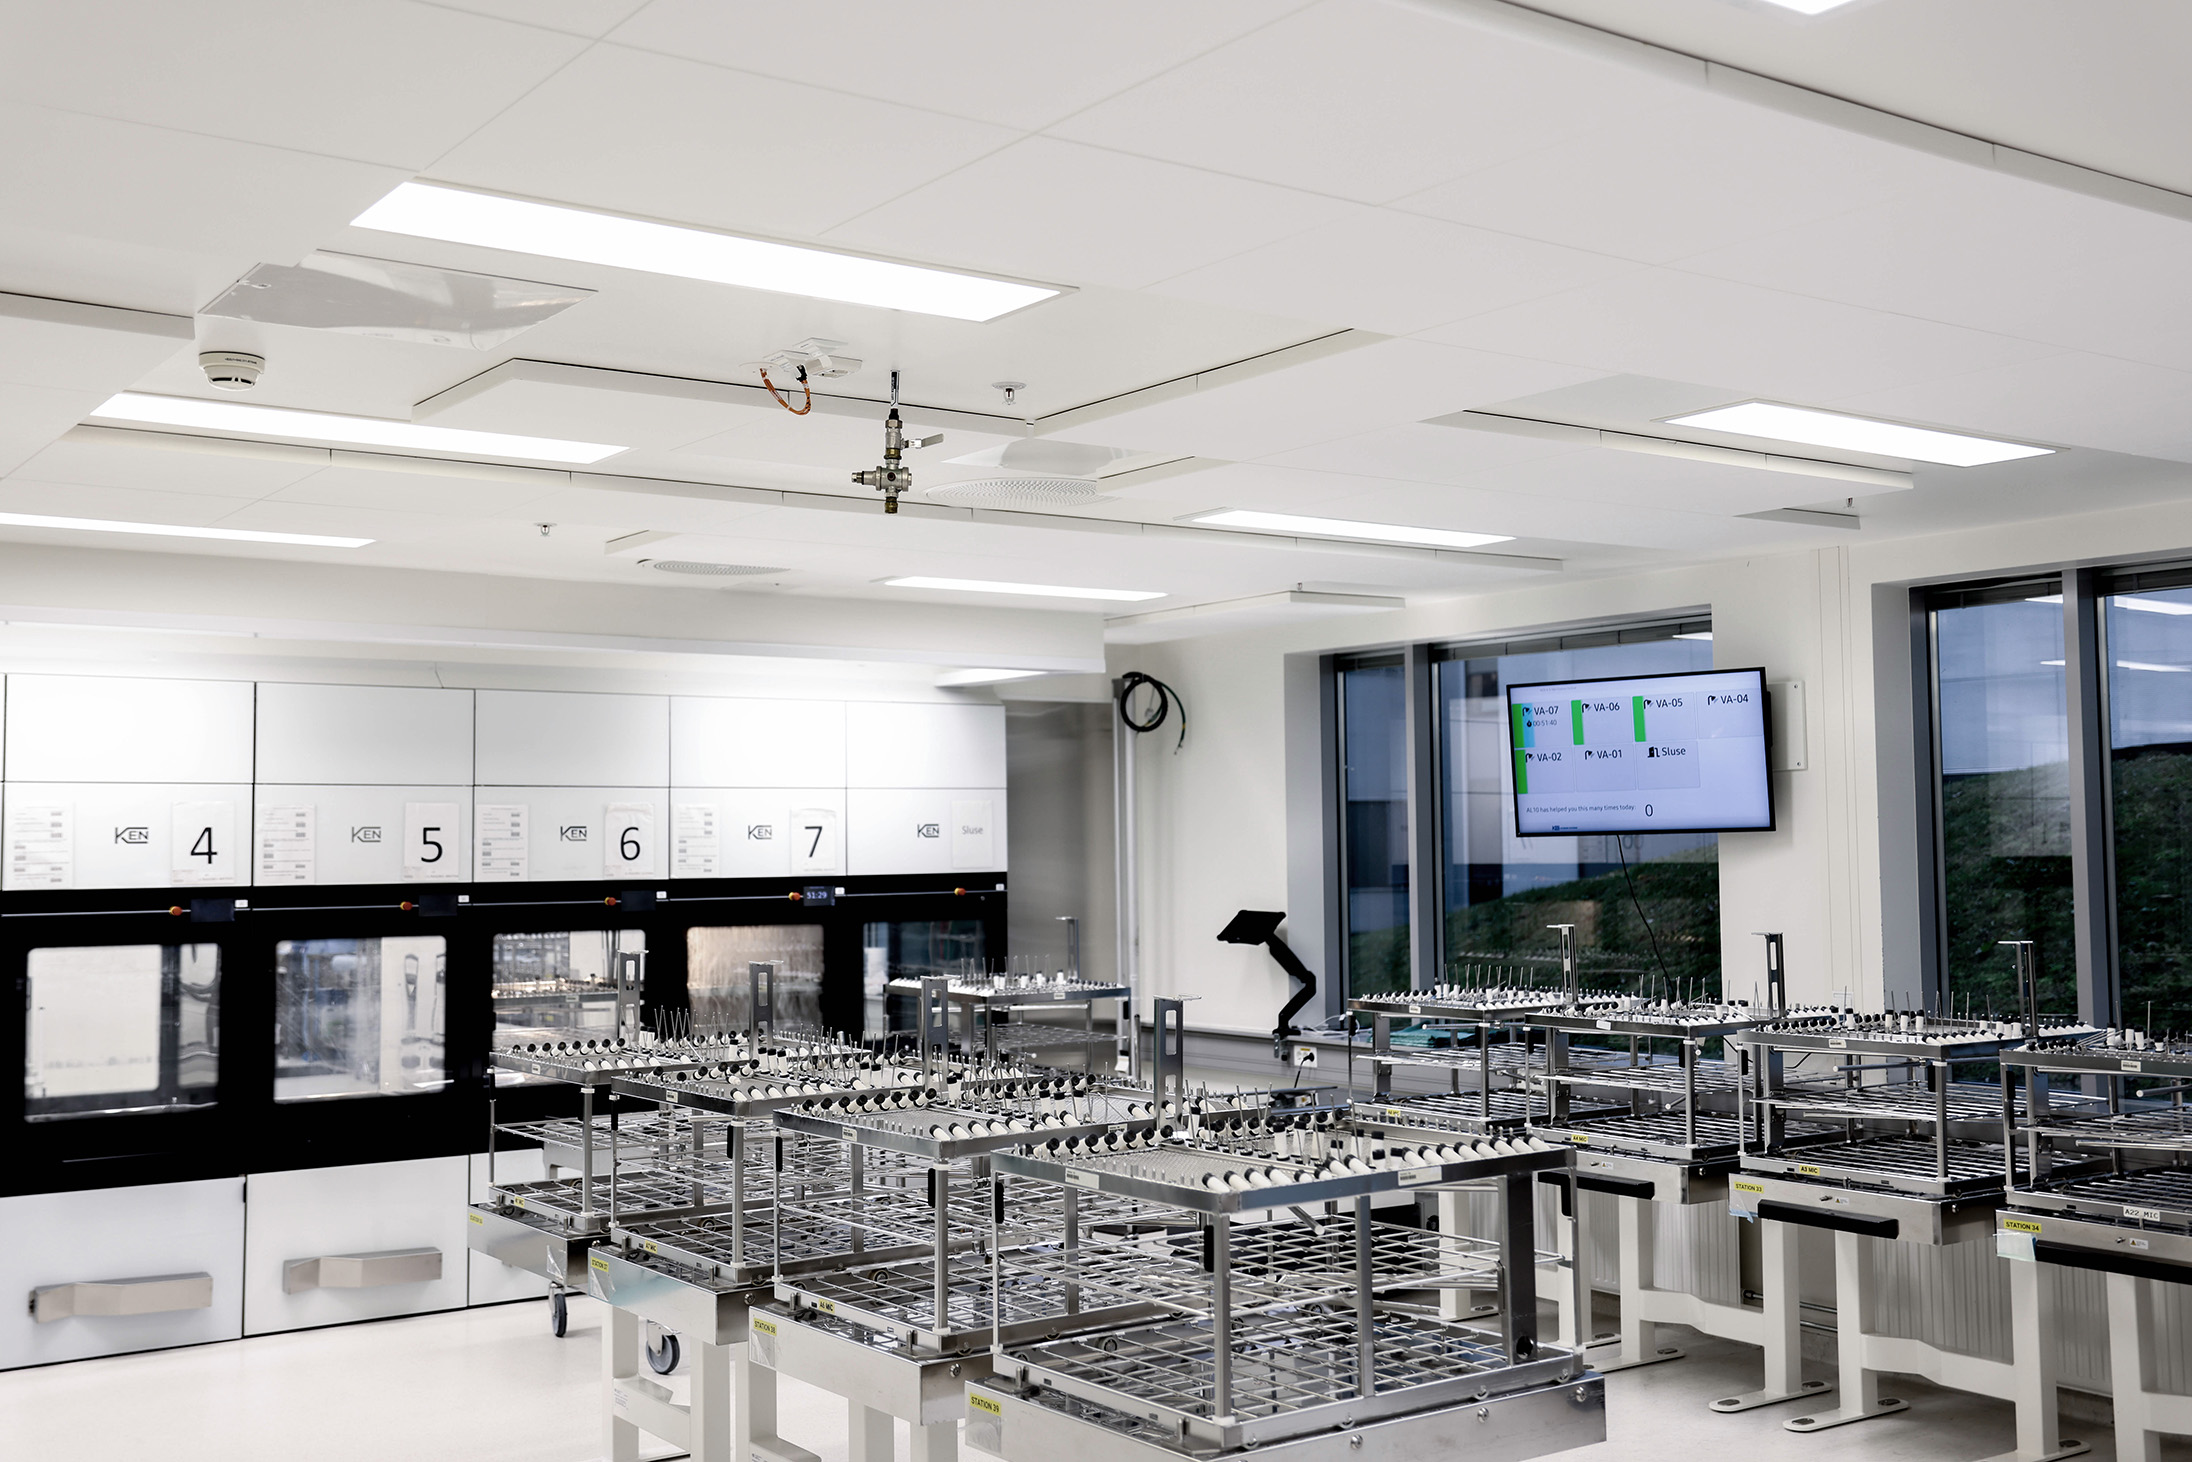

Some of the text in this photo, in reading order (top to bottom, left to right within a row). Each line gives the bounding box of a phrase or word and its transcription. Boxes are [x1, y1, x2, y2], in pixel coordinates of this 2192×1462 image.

[1655, 698, 1683, 708] VA-05
[1720, 694, 1749, 704] VA-04
[1533, 706, 1559, 716] VA-07
[1593, 702, 1620, 712] VA-06
[1536, 752, 1562, 762] VA-02
[1596, 749, 1622, 759] VA-01
[1661, 747, 1686, 756] Sluse
[1645, 804, 1653, 817] 0
[114, 827, 149, 844] KEN
[351, 826, 381, 843] KEN
[560, 826, 587, 841] KEN
[748, 825, 772, 840] KEN
[917, 824, 939, 838] KEN
[961, 825, 984, 835] Sluse
[190, 827, 218, 864] 4
[420, 827, 443, 863] 5
[620, 826, 641, 861] 6
[804, 826, 823, 858] 7
[806, 891, 827, 899] 51:29
[1735, 1183, 1755, 1191] STATION
[2125, 1208, 2158, 1219] A22 MIC
[2005, 1221, 2040, 1232] STATION 34
[825, 1303, 833, 1311] MIC
[754, 1320, 771, 1332] STATION
[971, 1396, 1000, 1413] STATION 39
